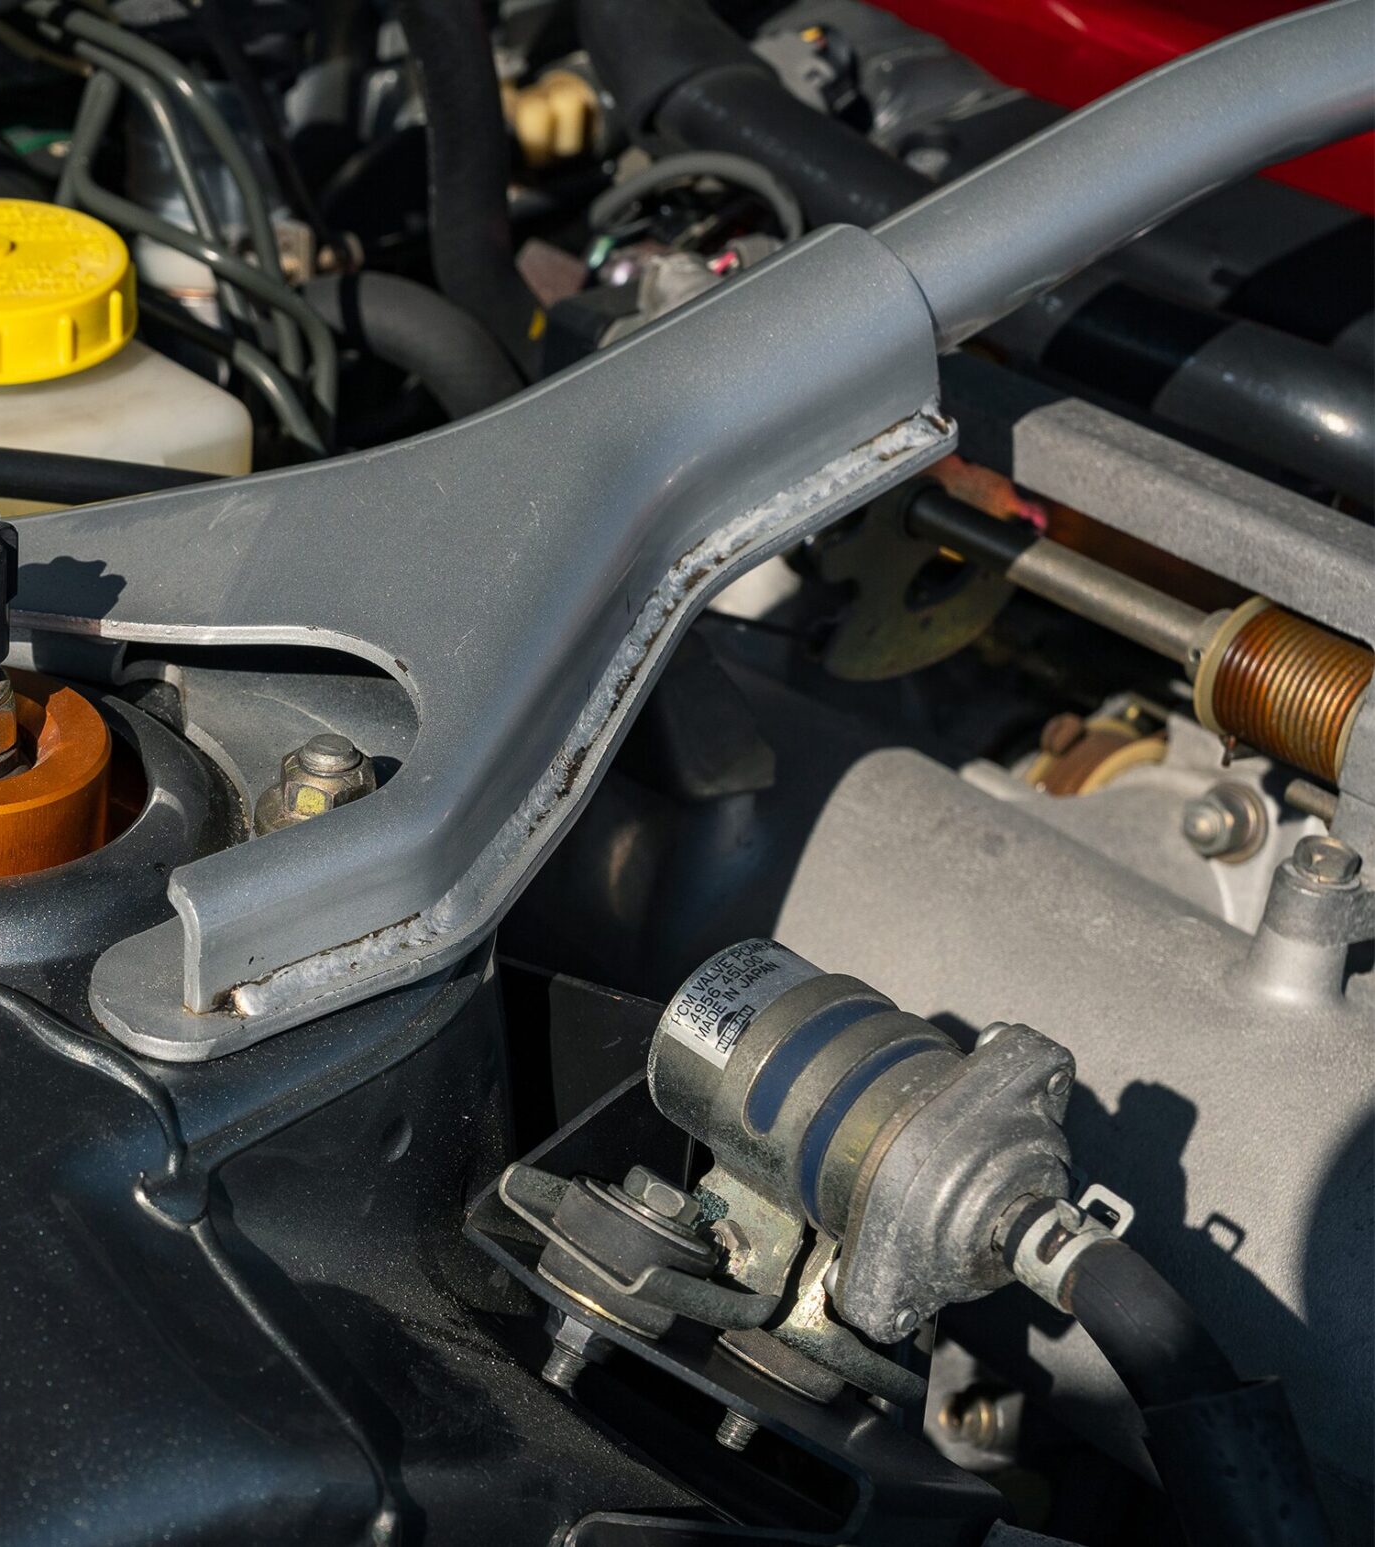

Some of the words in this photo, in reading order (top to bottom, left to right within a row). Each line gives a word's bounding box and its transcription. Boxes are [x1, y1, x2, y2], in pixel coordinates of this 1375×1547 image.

[671, 993, 699, 1026] PCM
[692, 957, 734, 993] VALVE
[721, 955, 763, 985] 45L00
[695, 1004, 728, 1042] MADE
[722, 987, 741, 1002] IN
[740, 961, 781, 989] JAPAN
[716, 1004, 756, 1054] NISSAN
